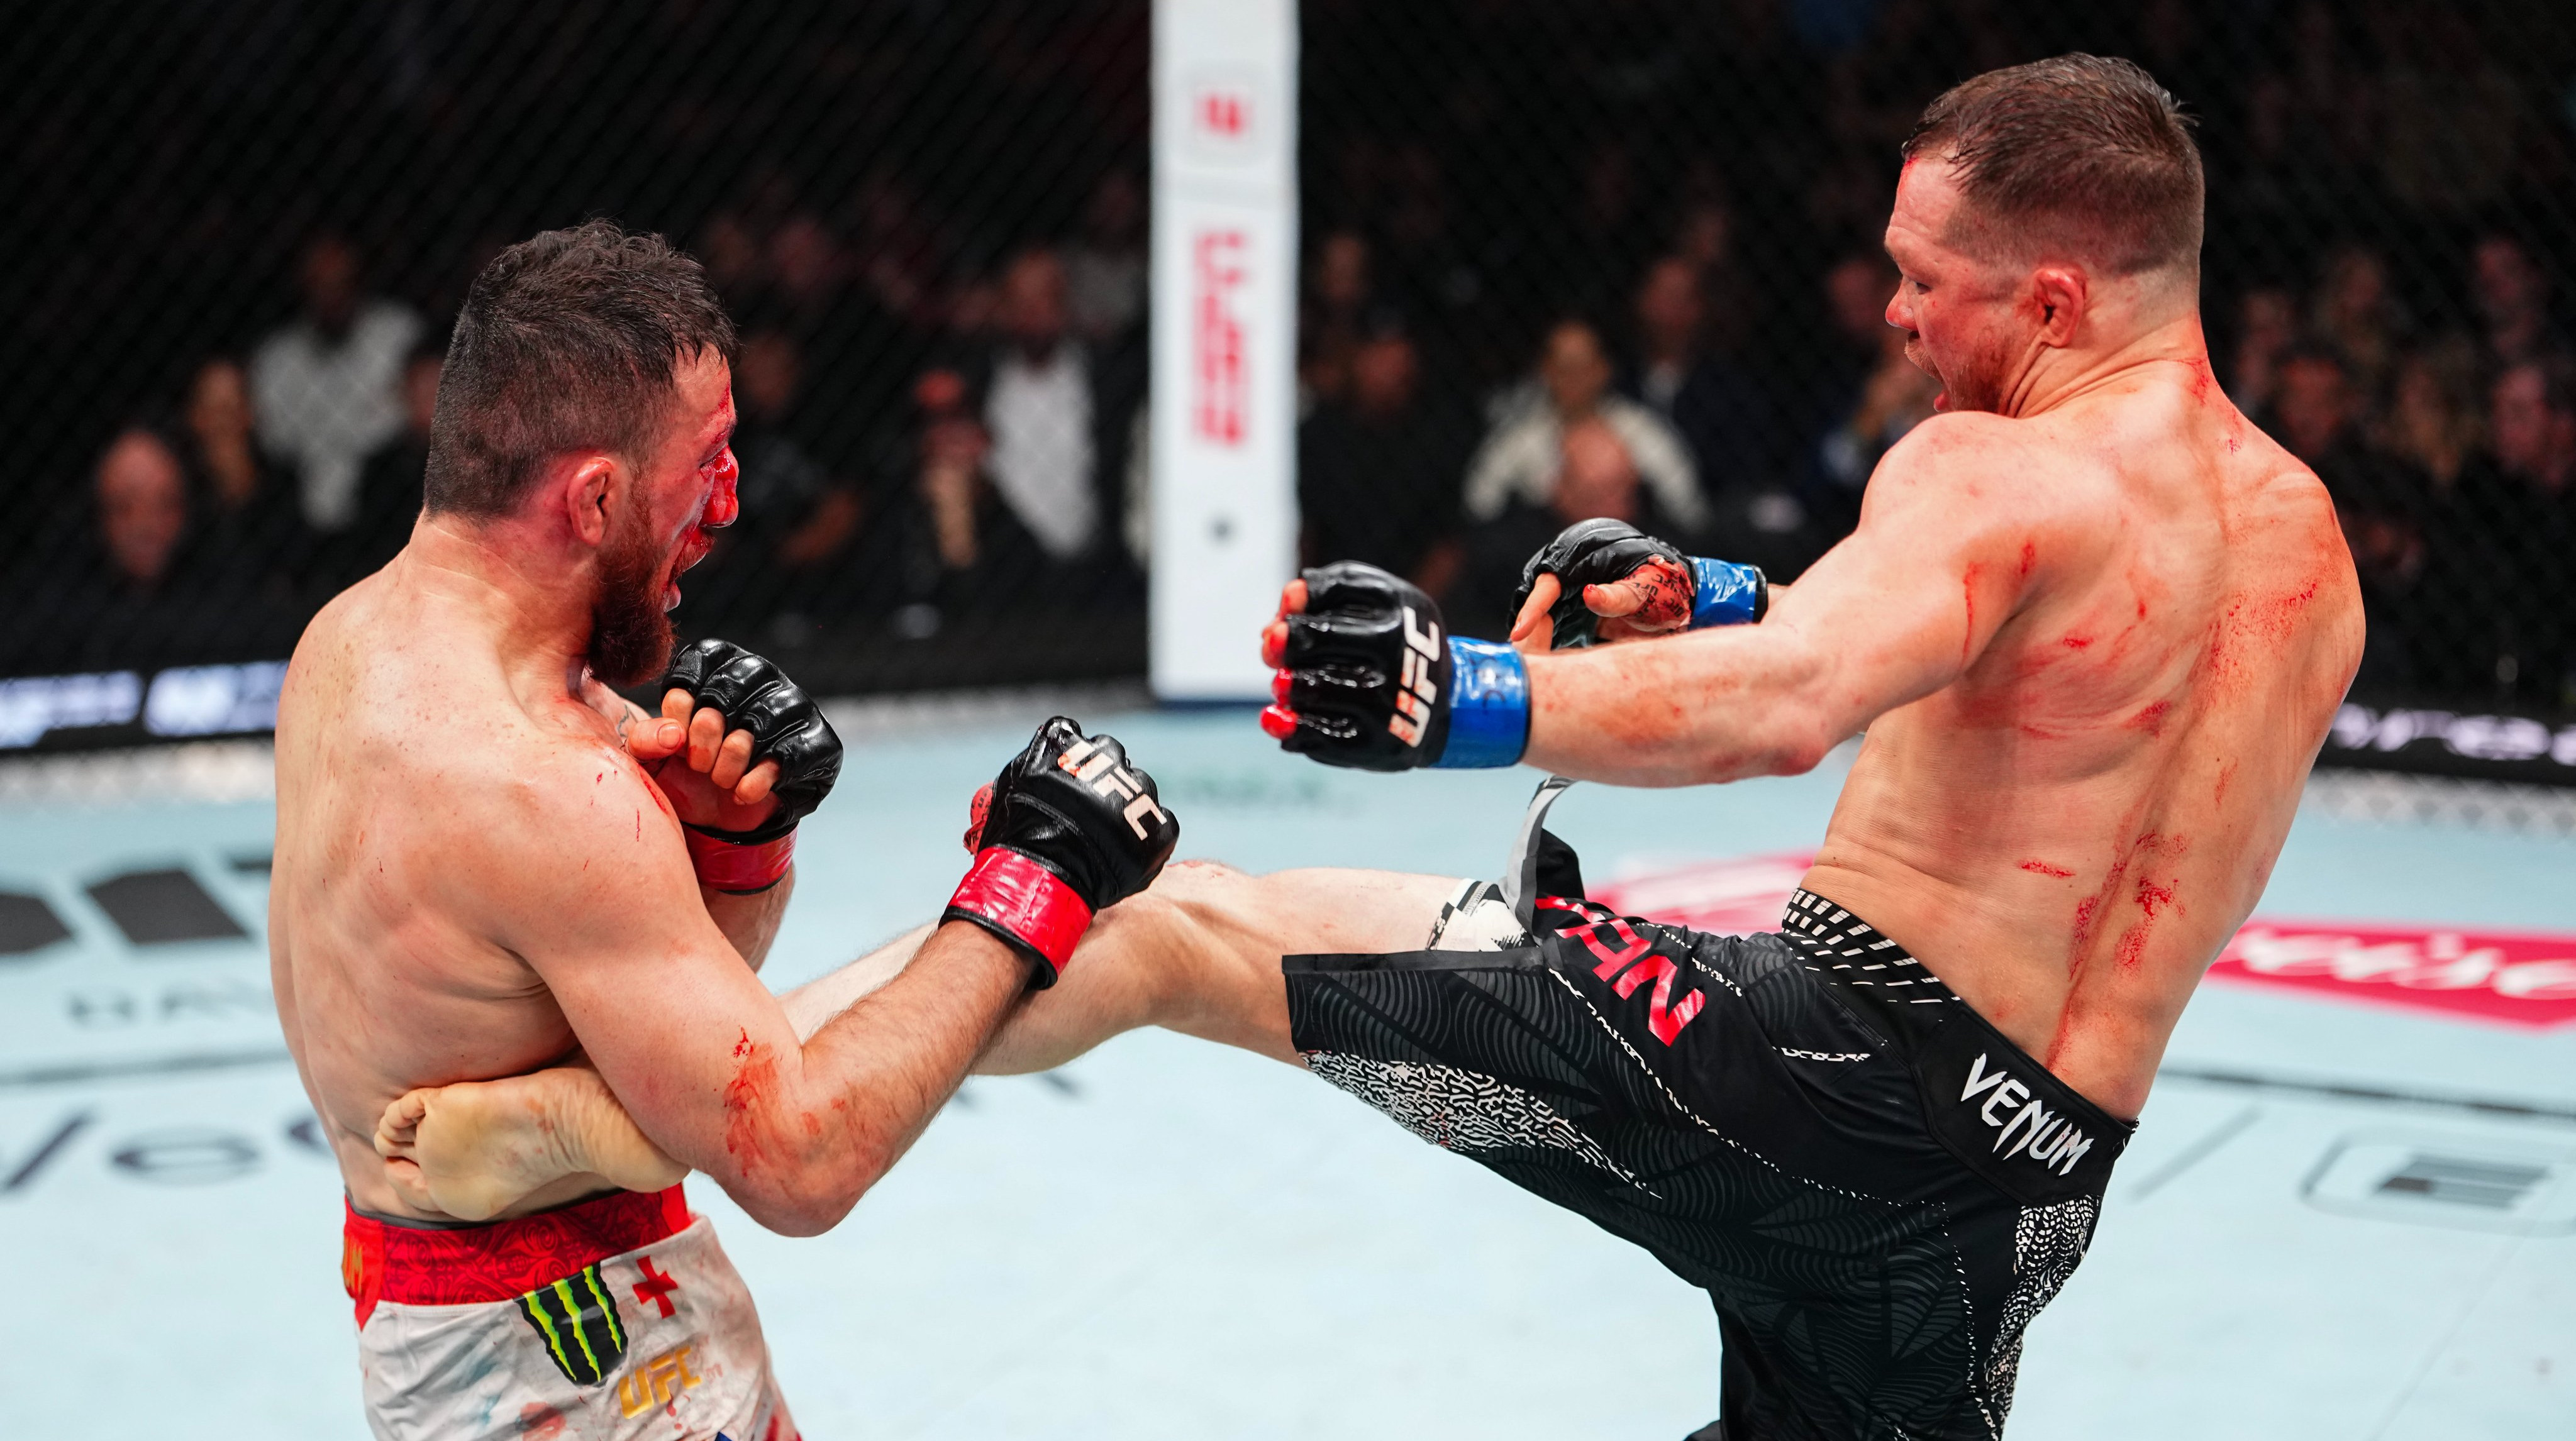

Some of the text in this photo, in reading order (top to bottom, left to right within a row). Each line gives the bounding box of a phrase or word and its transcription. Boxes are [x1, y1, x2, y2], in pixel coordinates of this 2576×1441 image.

[1192, 228, 1249, 446] ESPN
[1388, 605, 1440, 748] UFC
[1057, 740, 1167, 841] UFC
[1960, 1052, 2095, 1176] VENUM
[618, 1345, 703, 1420] UFC
